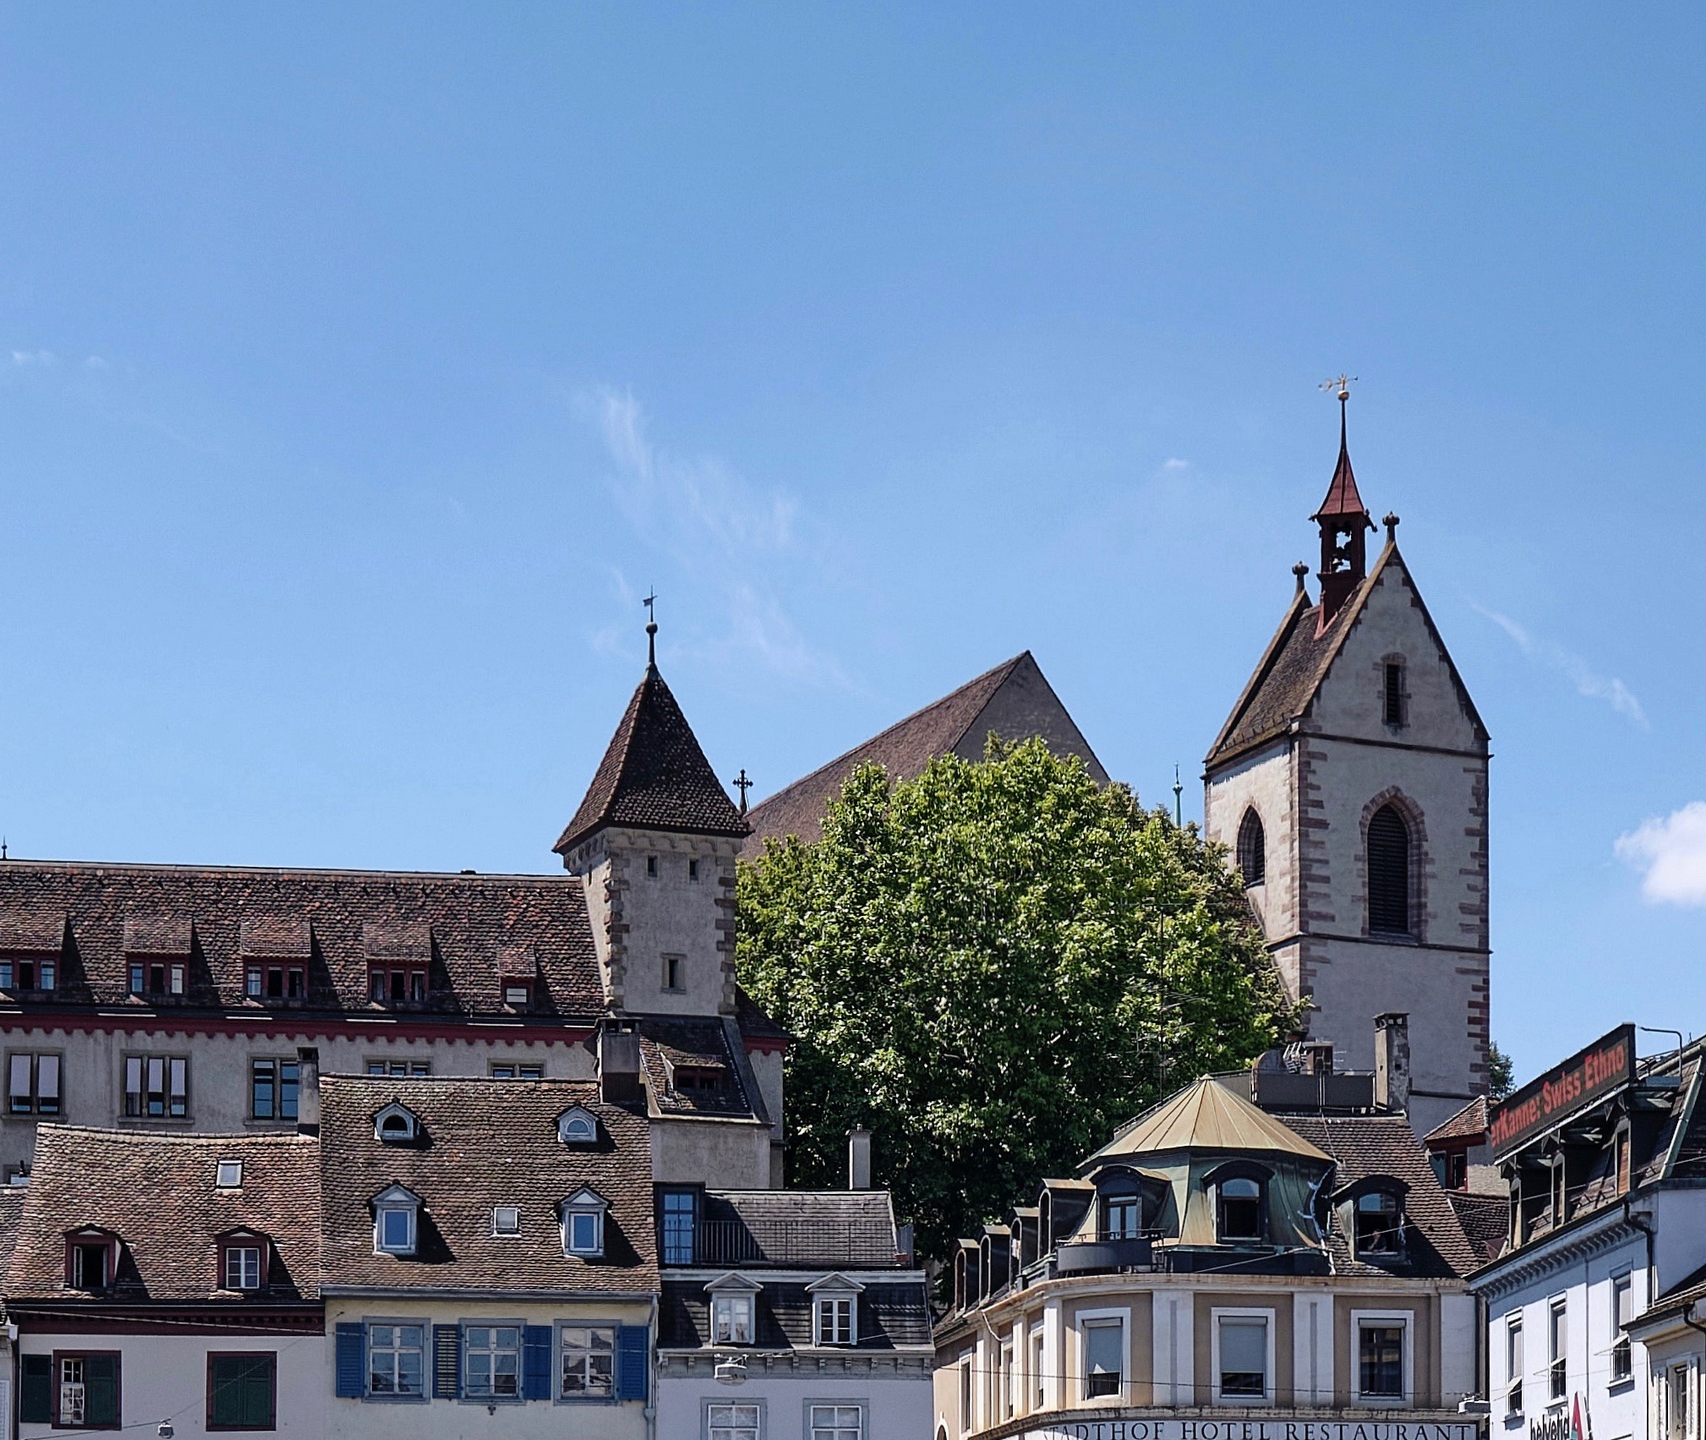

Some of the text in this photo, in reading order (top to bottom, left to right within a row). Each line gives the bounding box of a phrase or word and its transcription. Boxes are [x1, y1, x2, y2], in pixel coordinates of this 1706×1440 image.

[1542, 1071, 1581, 1114] Swiss
[1584, 1044, 1624, 1090] Ethno
[1181, 1422, 1271, 1440] HOTEL
